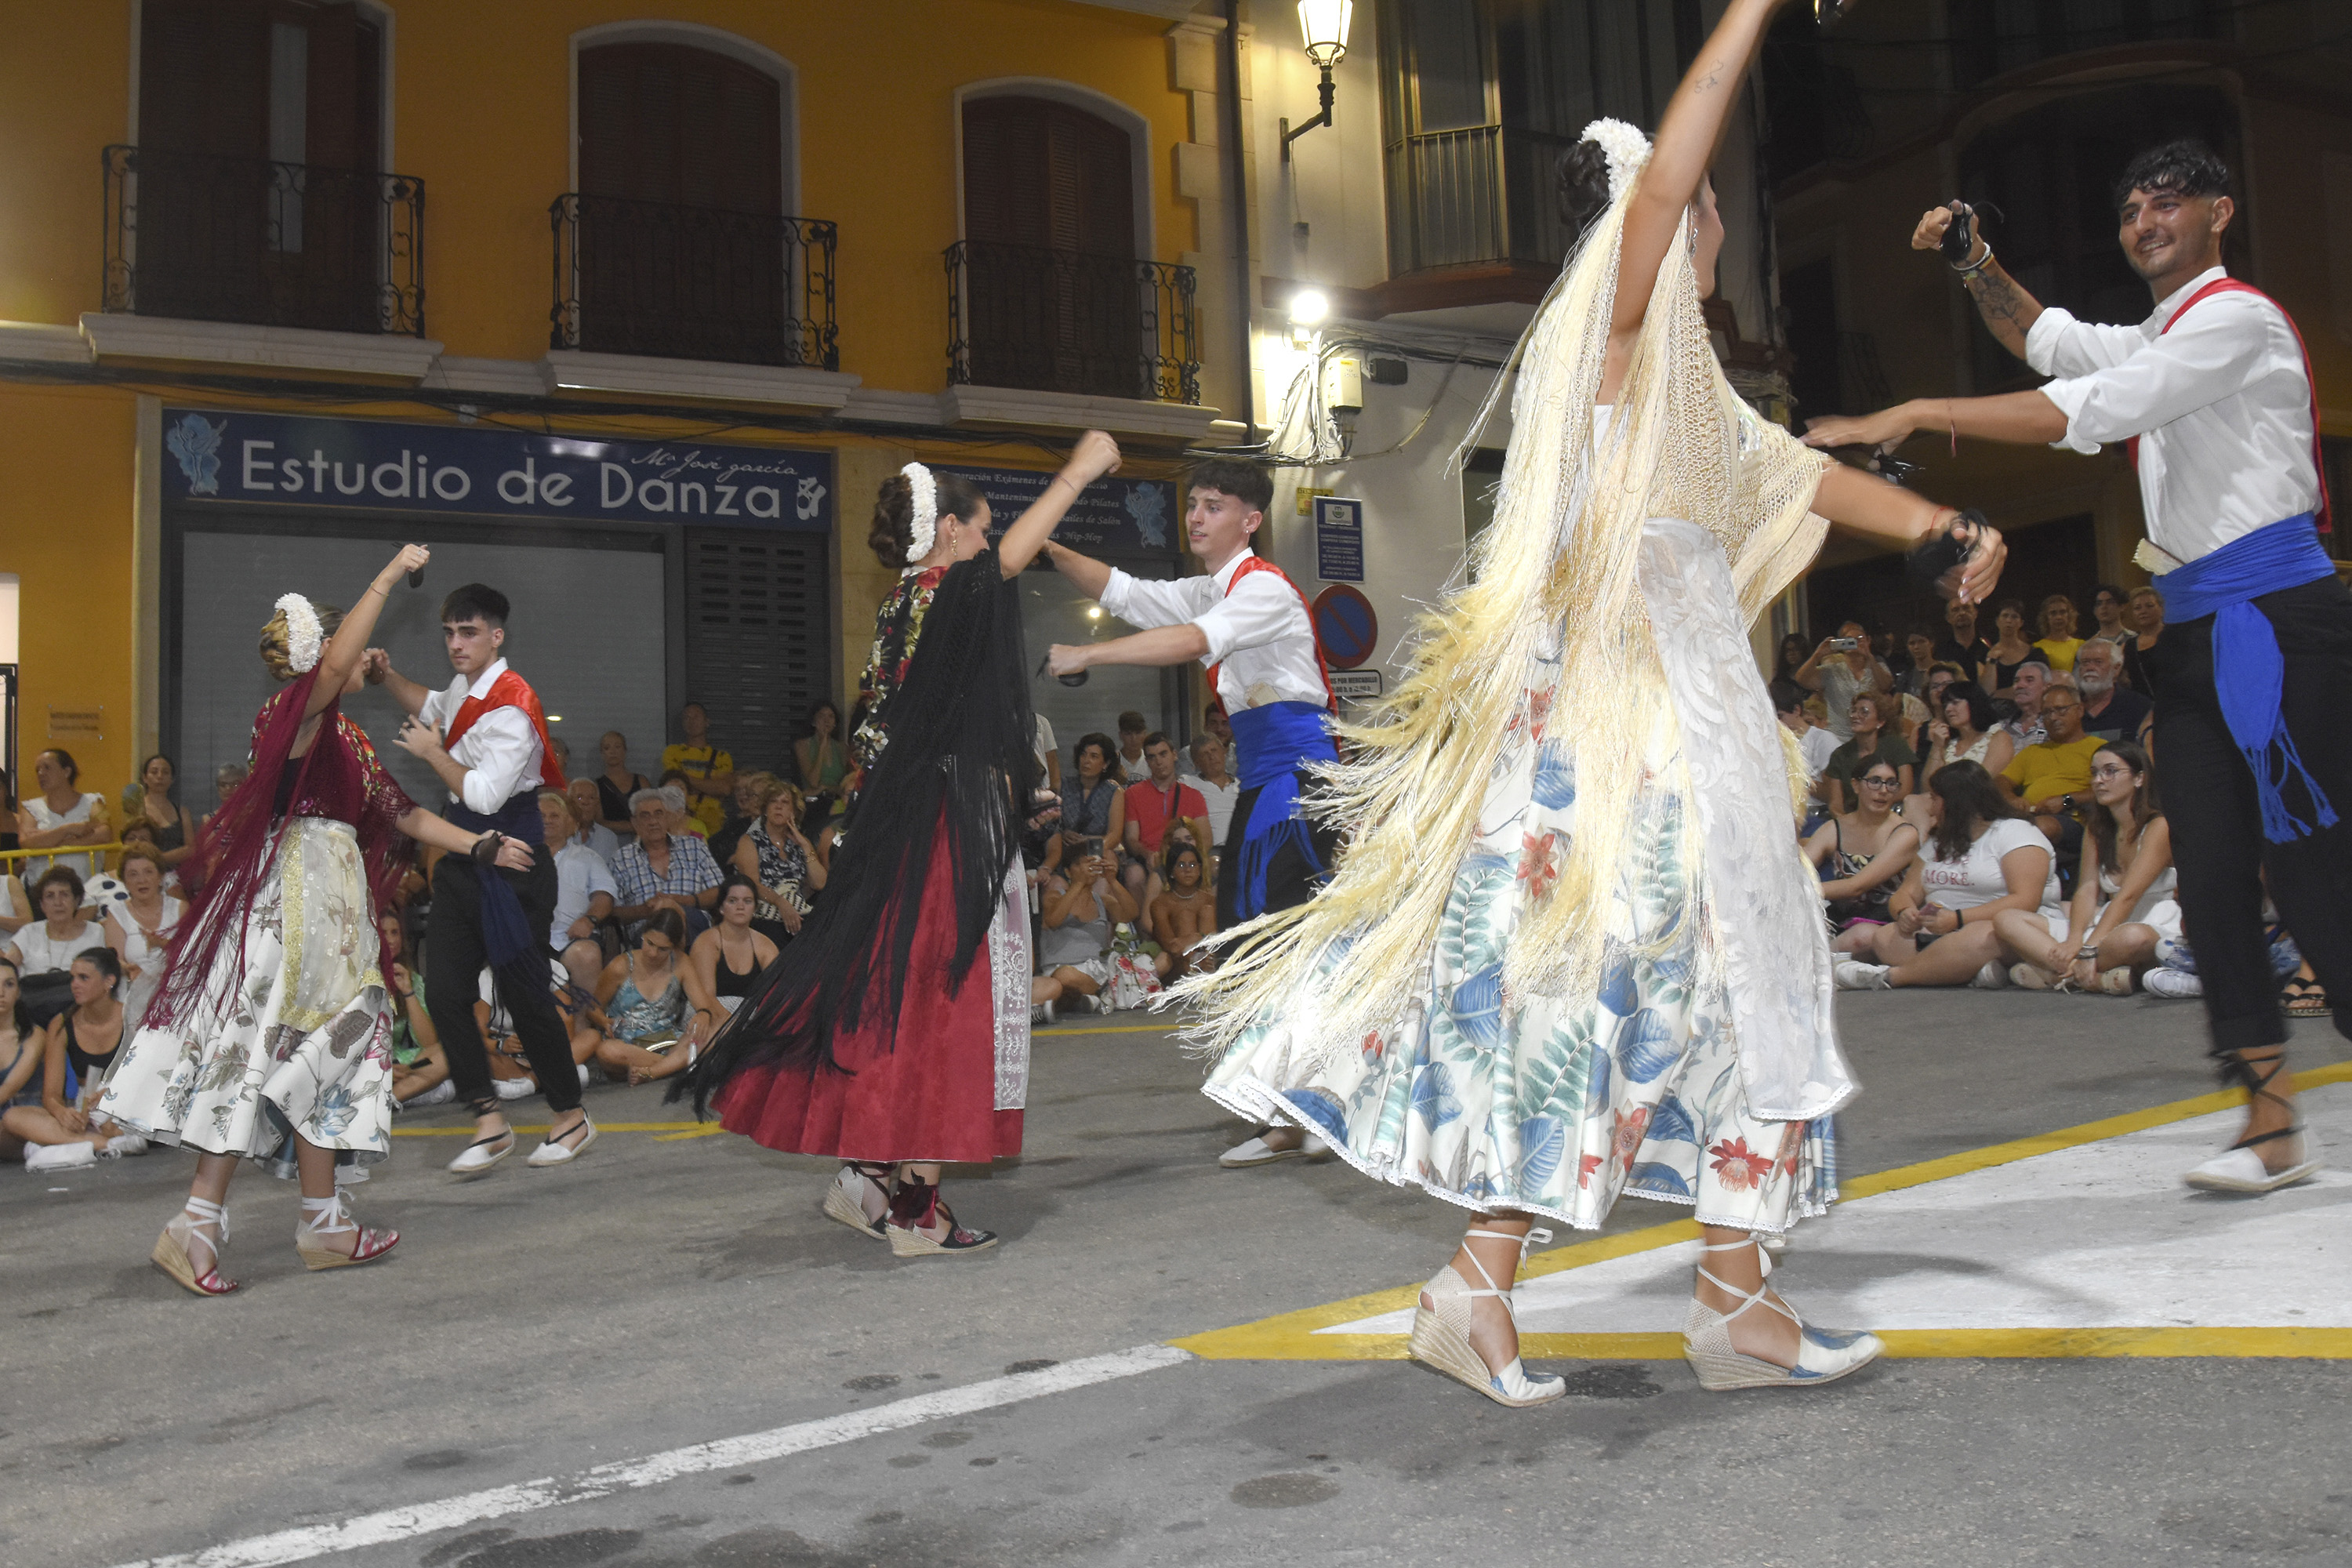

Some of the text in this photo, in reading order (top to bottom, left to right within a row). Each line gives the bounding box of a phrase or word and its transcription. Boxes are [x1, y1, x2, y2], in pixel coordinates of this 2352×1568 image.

[660, 450, 721, 480] José
[242, 439, 780, 519] Estudio de Danza
[994, 474, 1036, 485] Exámenes
[1038, 477, 1048, 485] de
[1091, 498, 1120, 508] Pilates
[1002, 511, 1009, 520] y
[1086, 514, 1095, 523] de
[1098, 515, 1121, 525] Salón
[1065, 532, 1103, 543] Hip-Hop
[1924, 869, 1975, 886] MORE.
